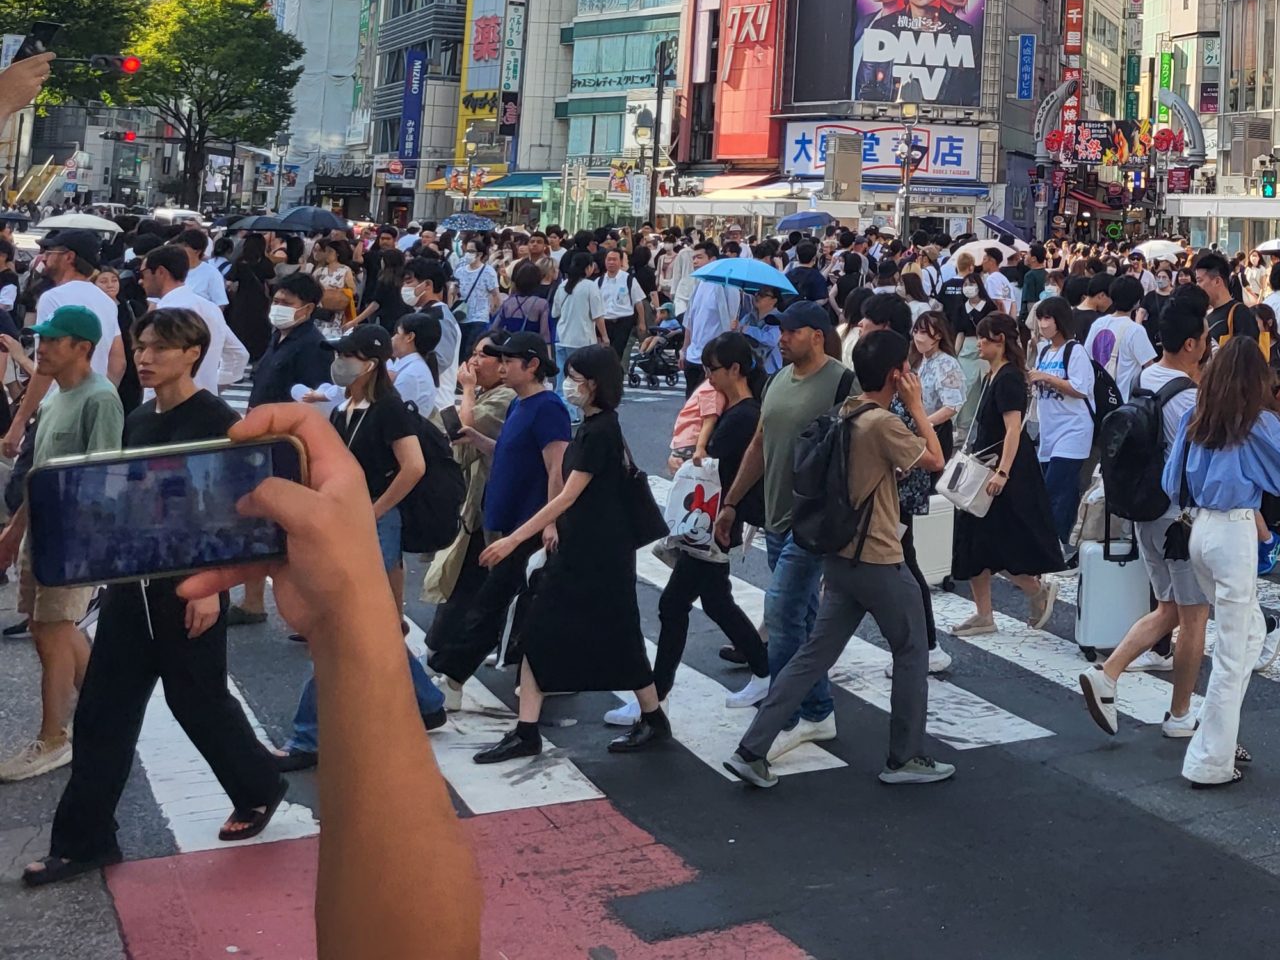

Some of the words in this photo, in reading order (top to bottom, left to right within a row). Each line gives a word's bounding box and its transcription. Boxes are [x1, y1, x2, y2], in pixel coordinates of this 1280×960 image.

[473, 15, 502, 62] 薬
[862, 28, 975, 68] DMM
[411, 59, 423, 95] MIZUHO
[893, 66, 947, 101] TV
[404, 119, 415, 157] みずほ銀行
